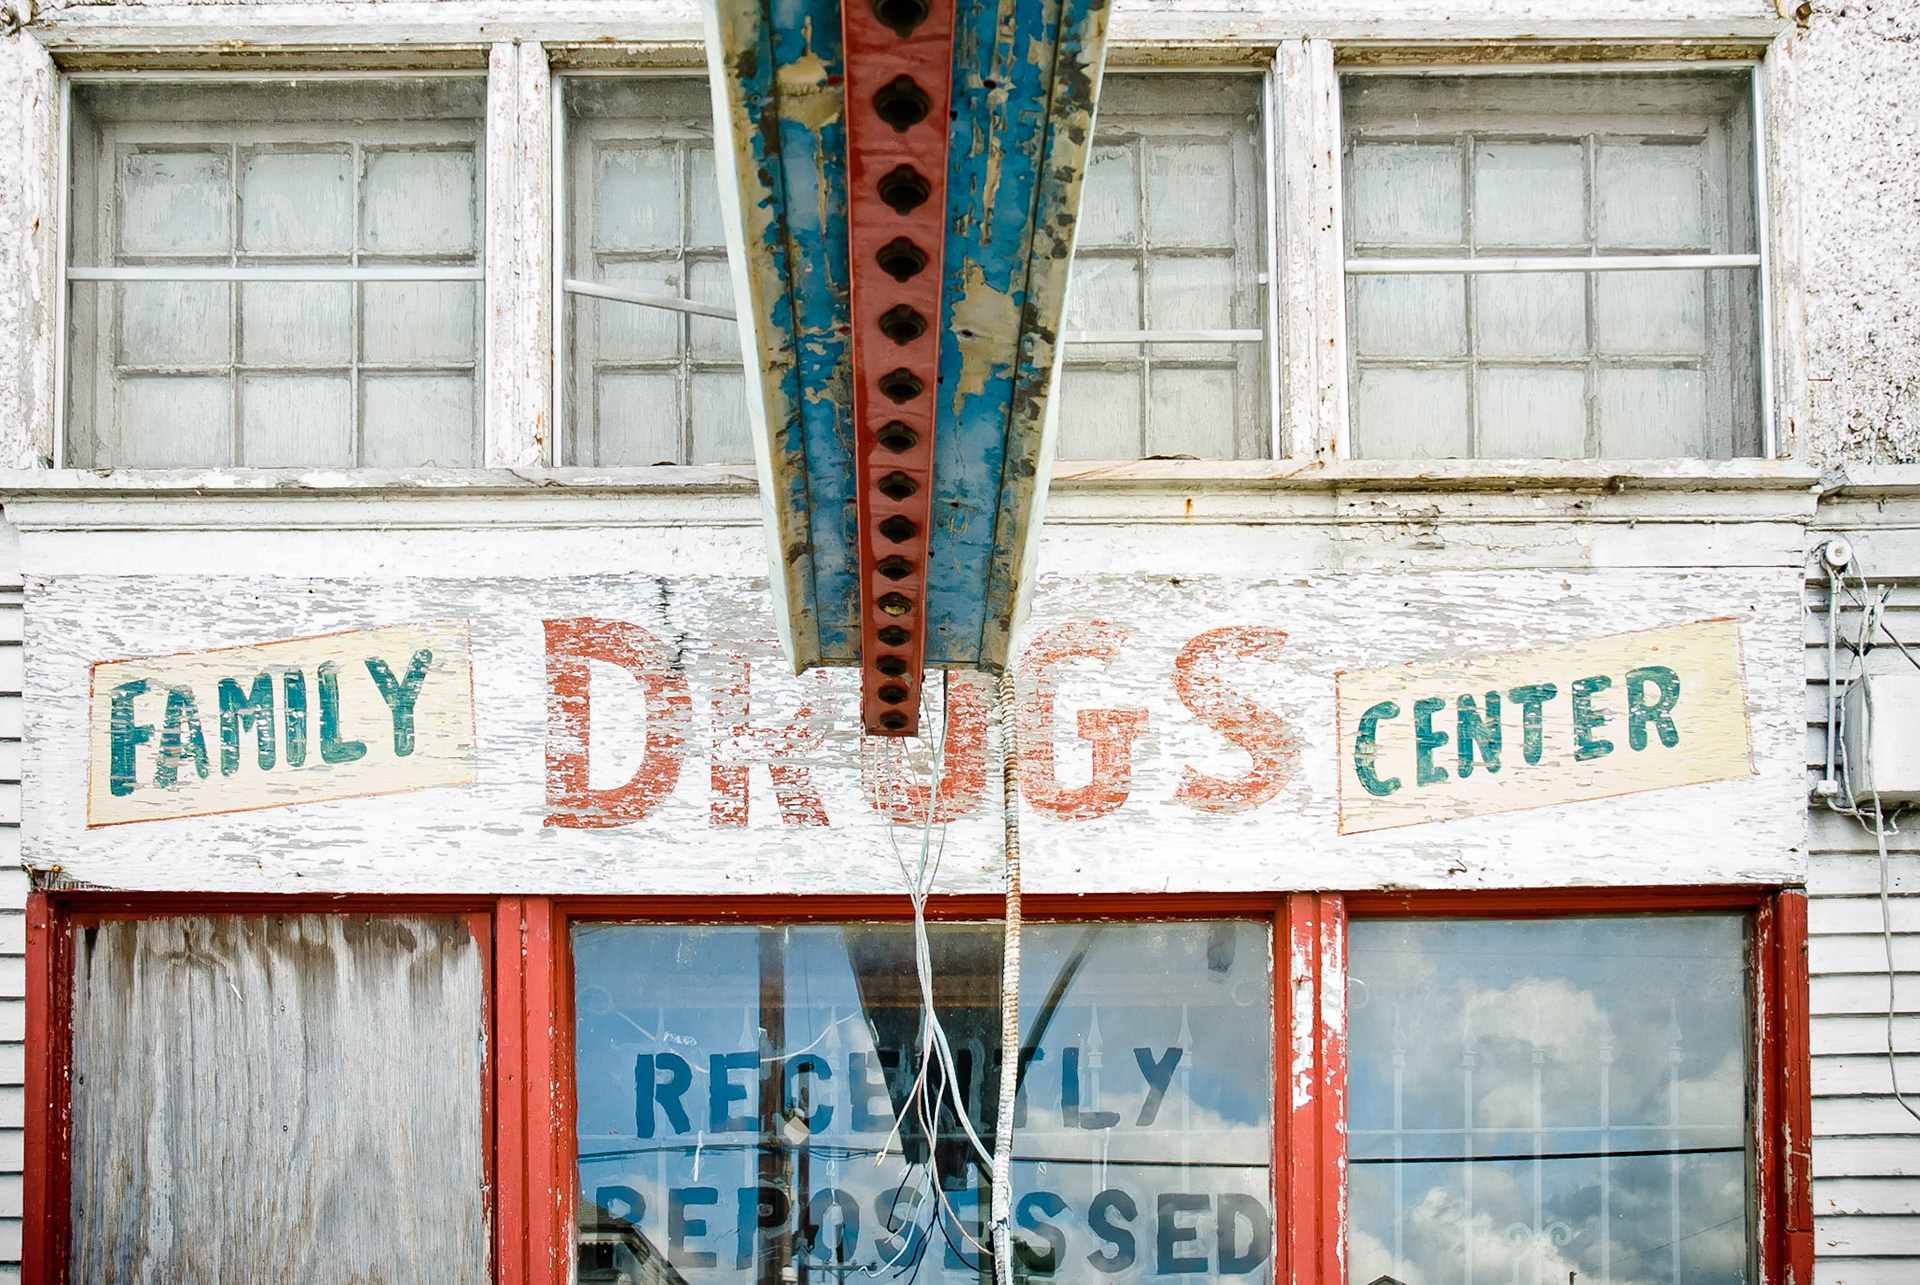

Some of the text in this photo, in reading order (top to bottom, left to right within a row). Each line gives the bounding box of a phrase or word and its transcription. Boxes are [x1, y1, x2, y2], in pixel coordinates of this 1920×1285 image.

[110, 617, 1681, 829] FAMILY DRUGS CENTER
